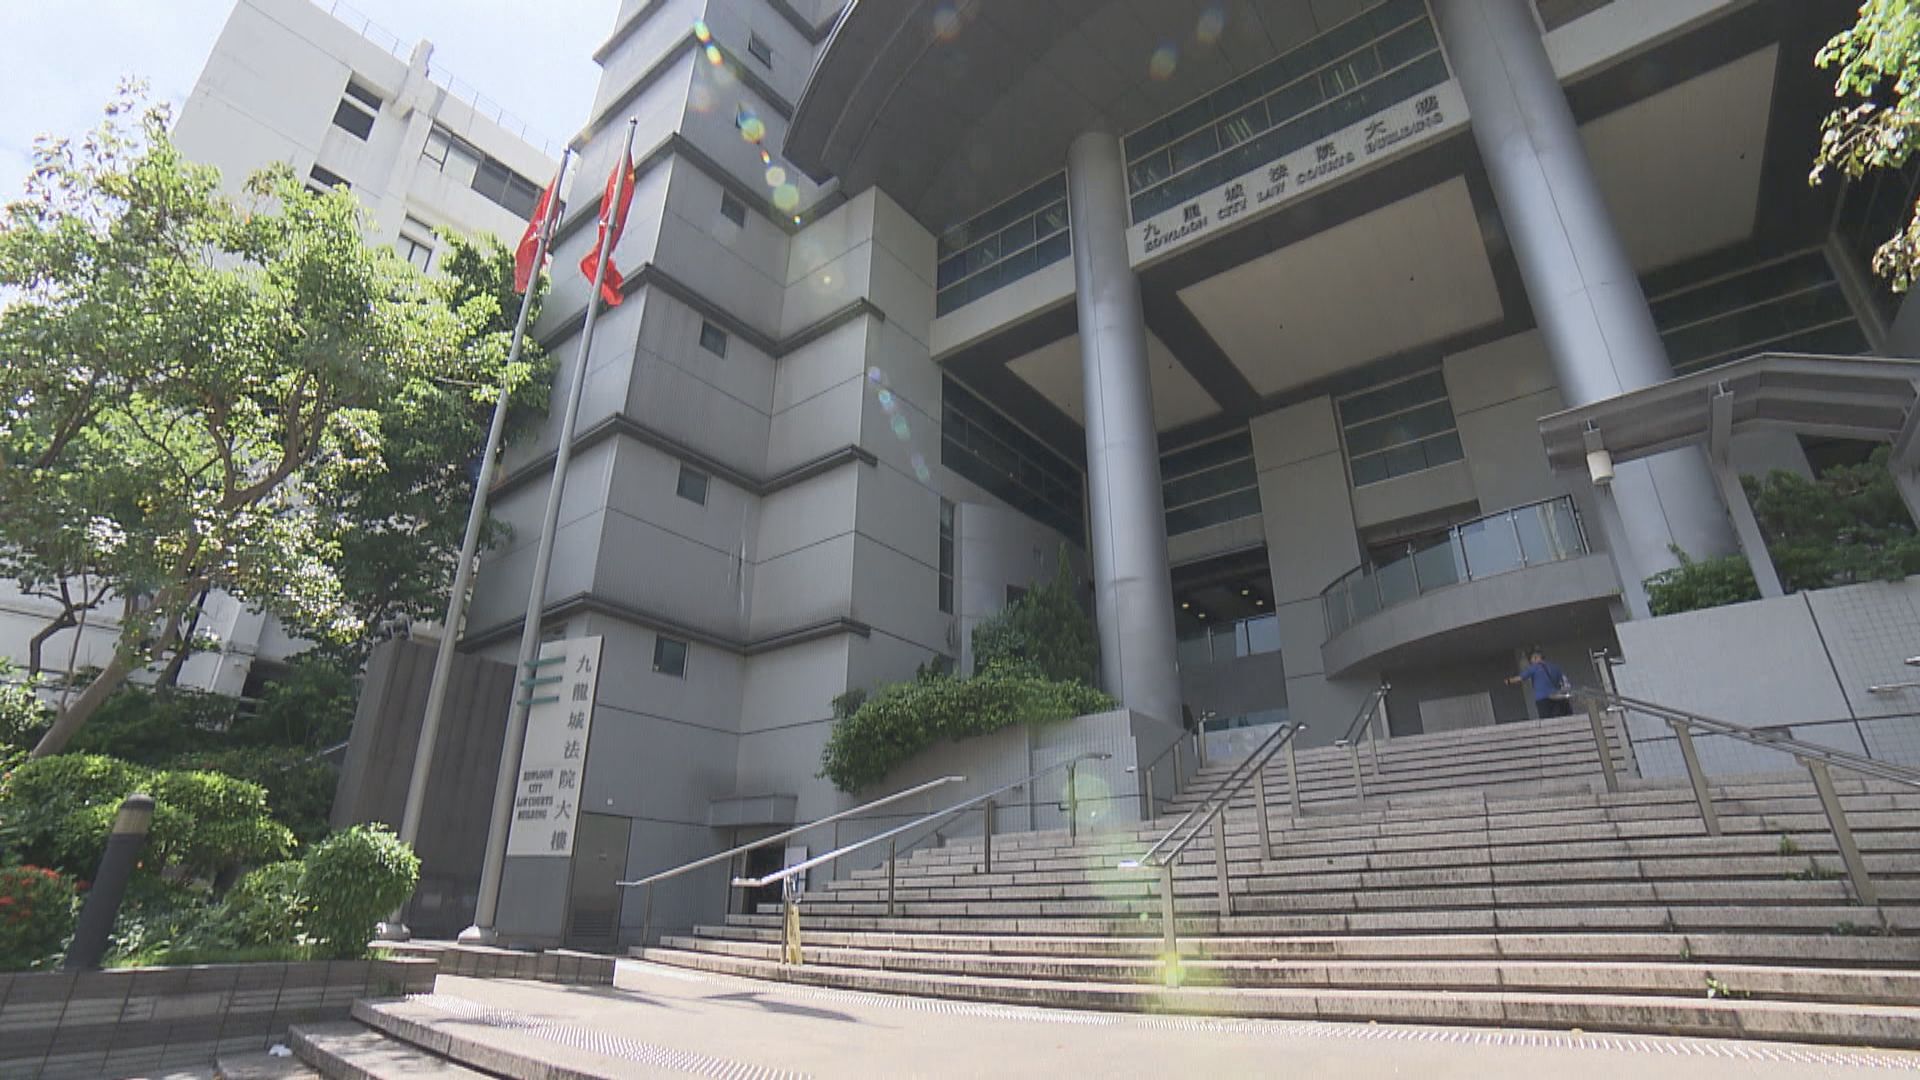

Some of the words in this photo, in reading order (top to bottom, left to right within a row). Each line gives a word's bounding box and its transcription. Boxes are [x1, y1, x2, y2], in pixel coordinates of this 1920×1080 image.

[1143, 96, 1440, 241] 九龍城法院大樓
[1144, 216, 1208, 253] KOWLOON
[1217, 199, 1248, 220] CITY
[1257, 181, 1286, 203] LAW
[1297, 151, 1355, 185] COURTS
[1365, 111, 1444, 155] BUILDING
[528, 783, 544, 793] CITY
[550, 654, 592, 851] 九龍城法院大樓
